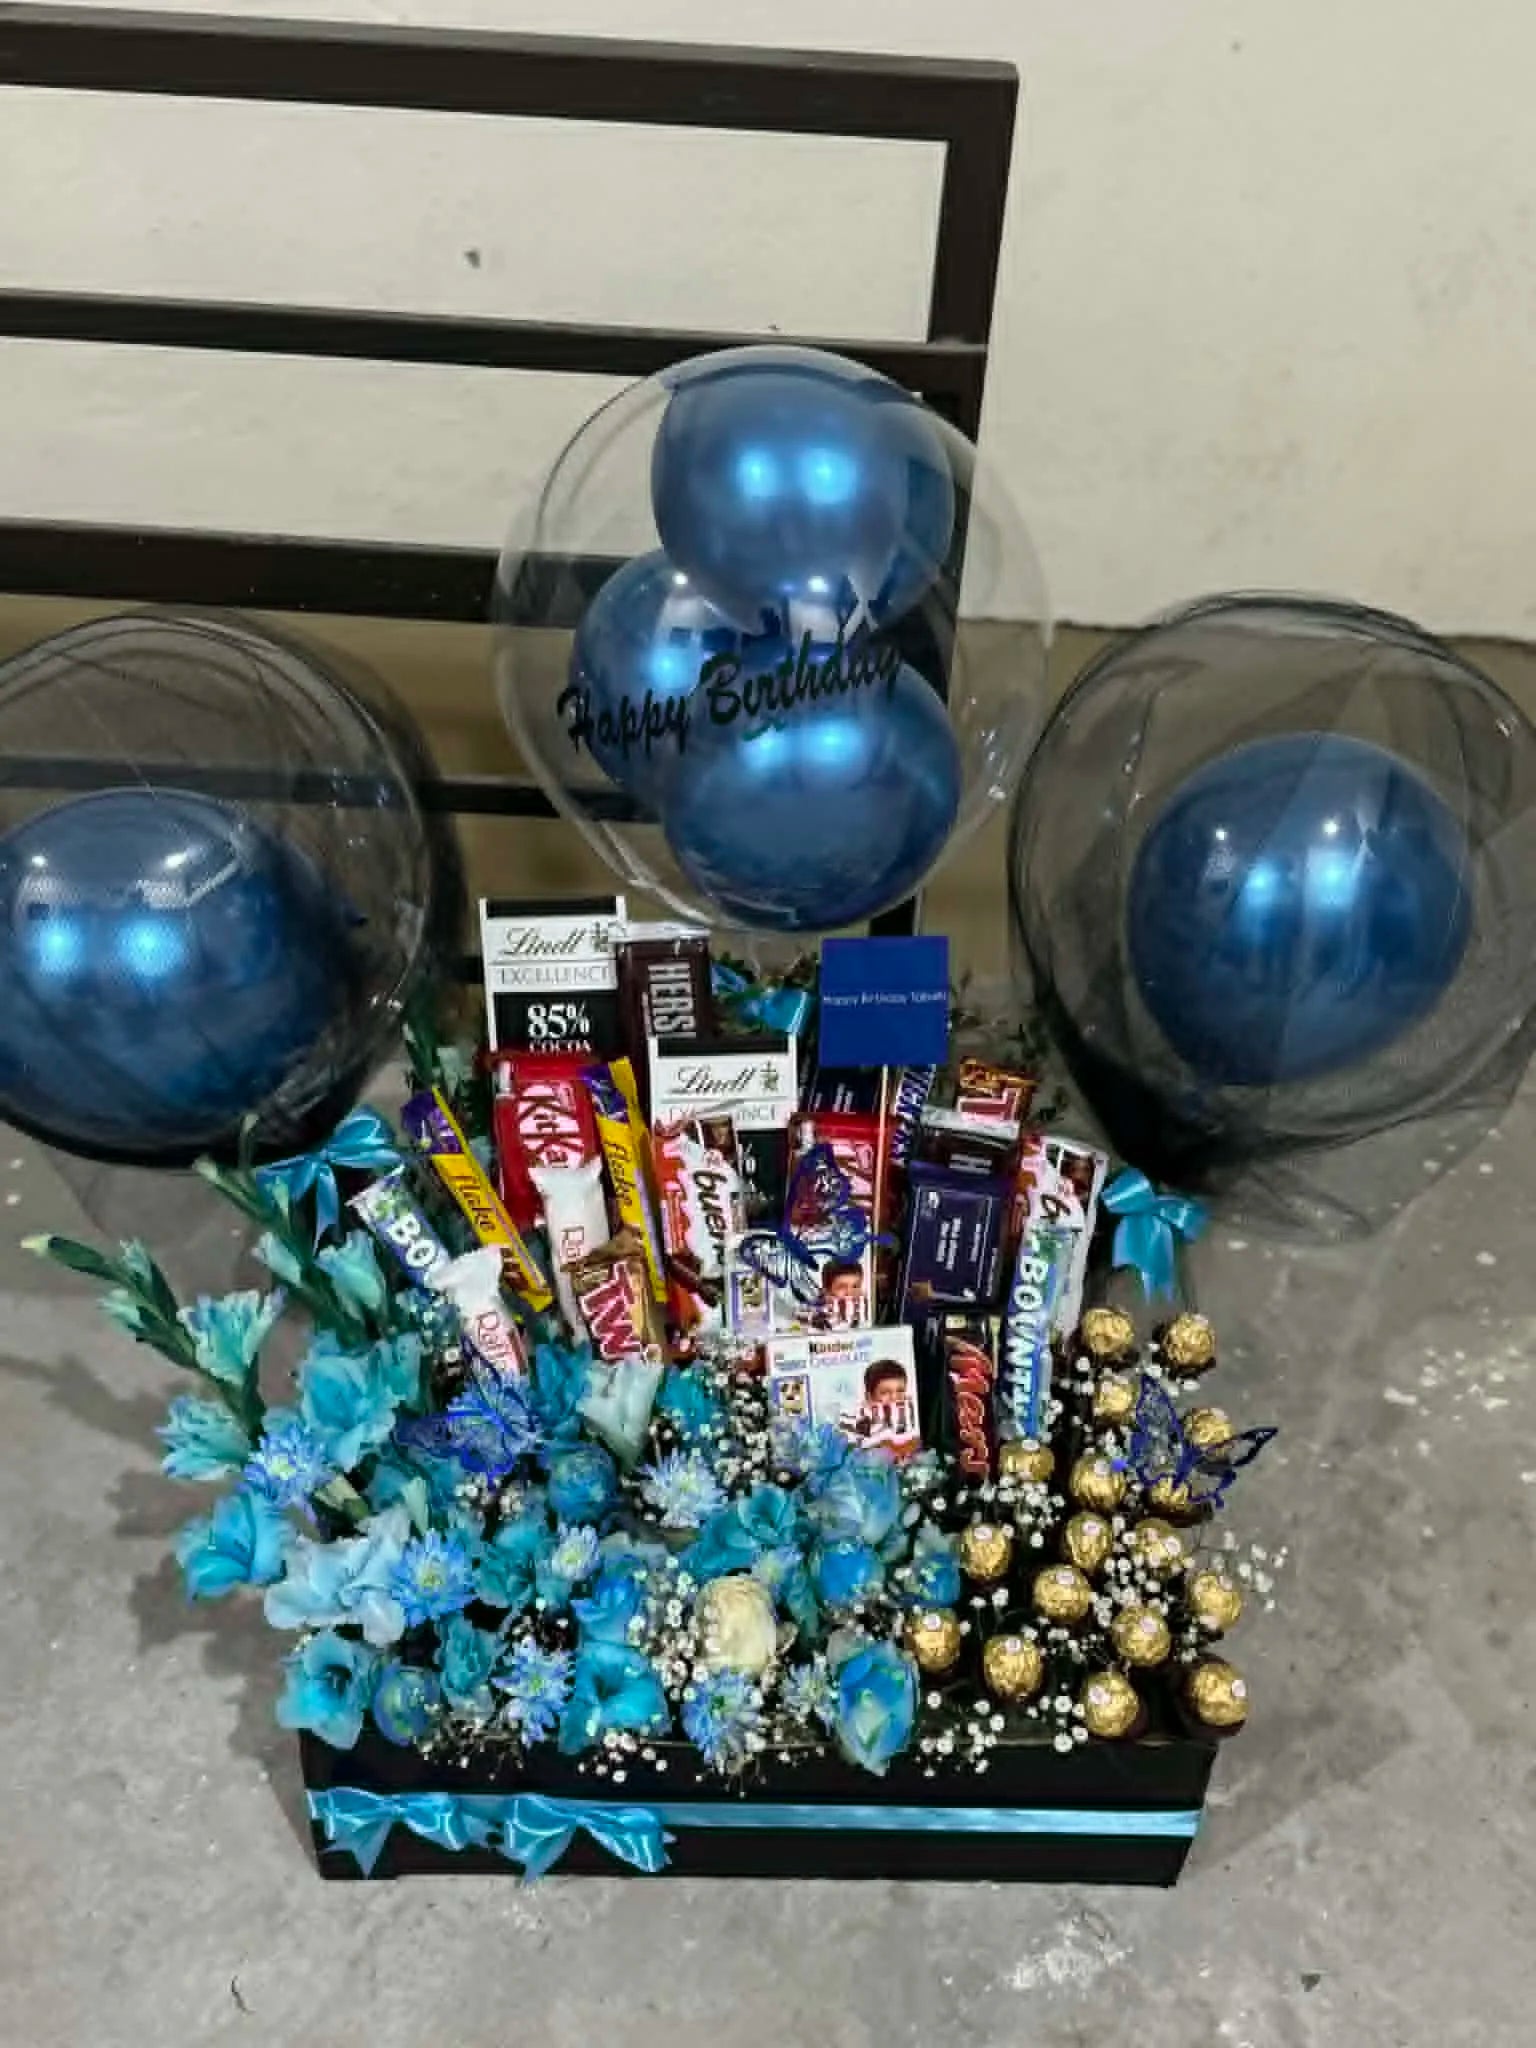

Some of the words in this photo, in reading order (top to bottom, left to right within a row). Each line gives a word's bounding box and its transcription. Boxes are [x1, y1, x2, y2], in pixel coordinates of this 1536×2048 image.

[556, 684, 698, 754] Happy
[698, 630, 898, 725] Birthday
[499, 926, 585, 957] Lindt
[527, 1001, 591, 1040] 85%
[668, 1066, 755, 1096] Lindt
